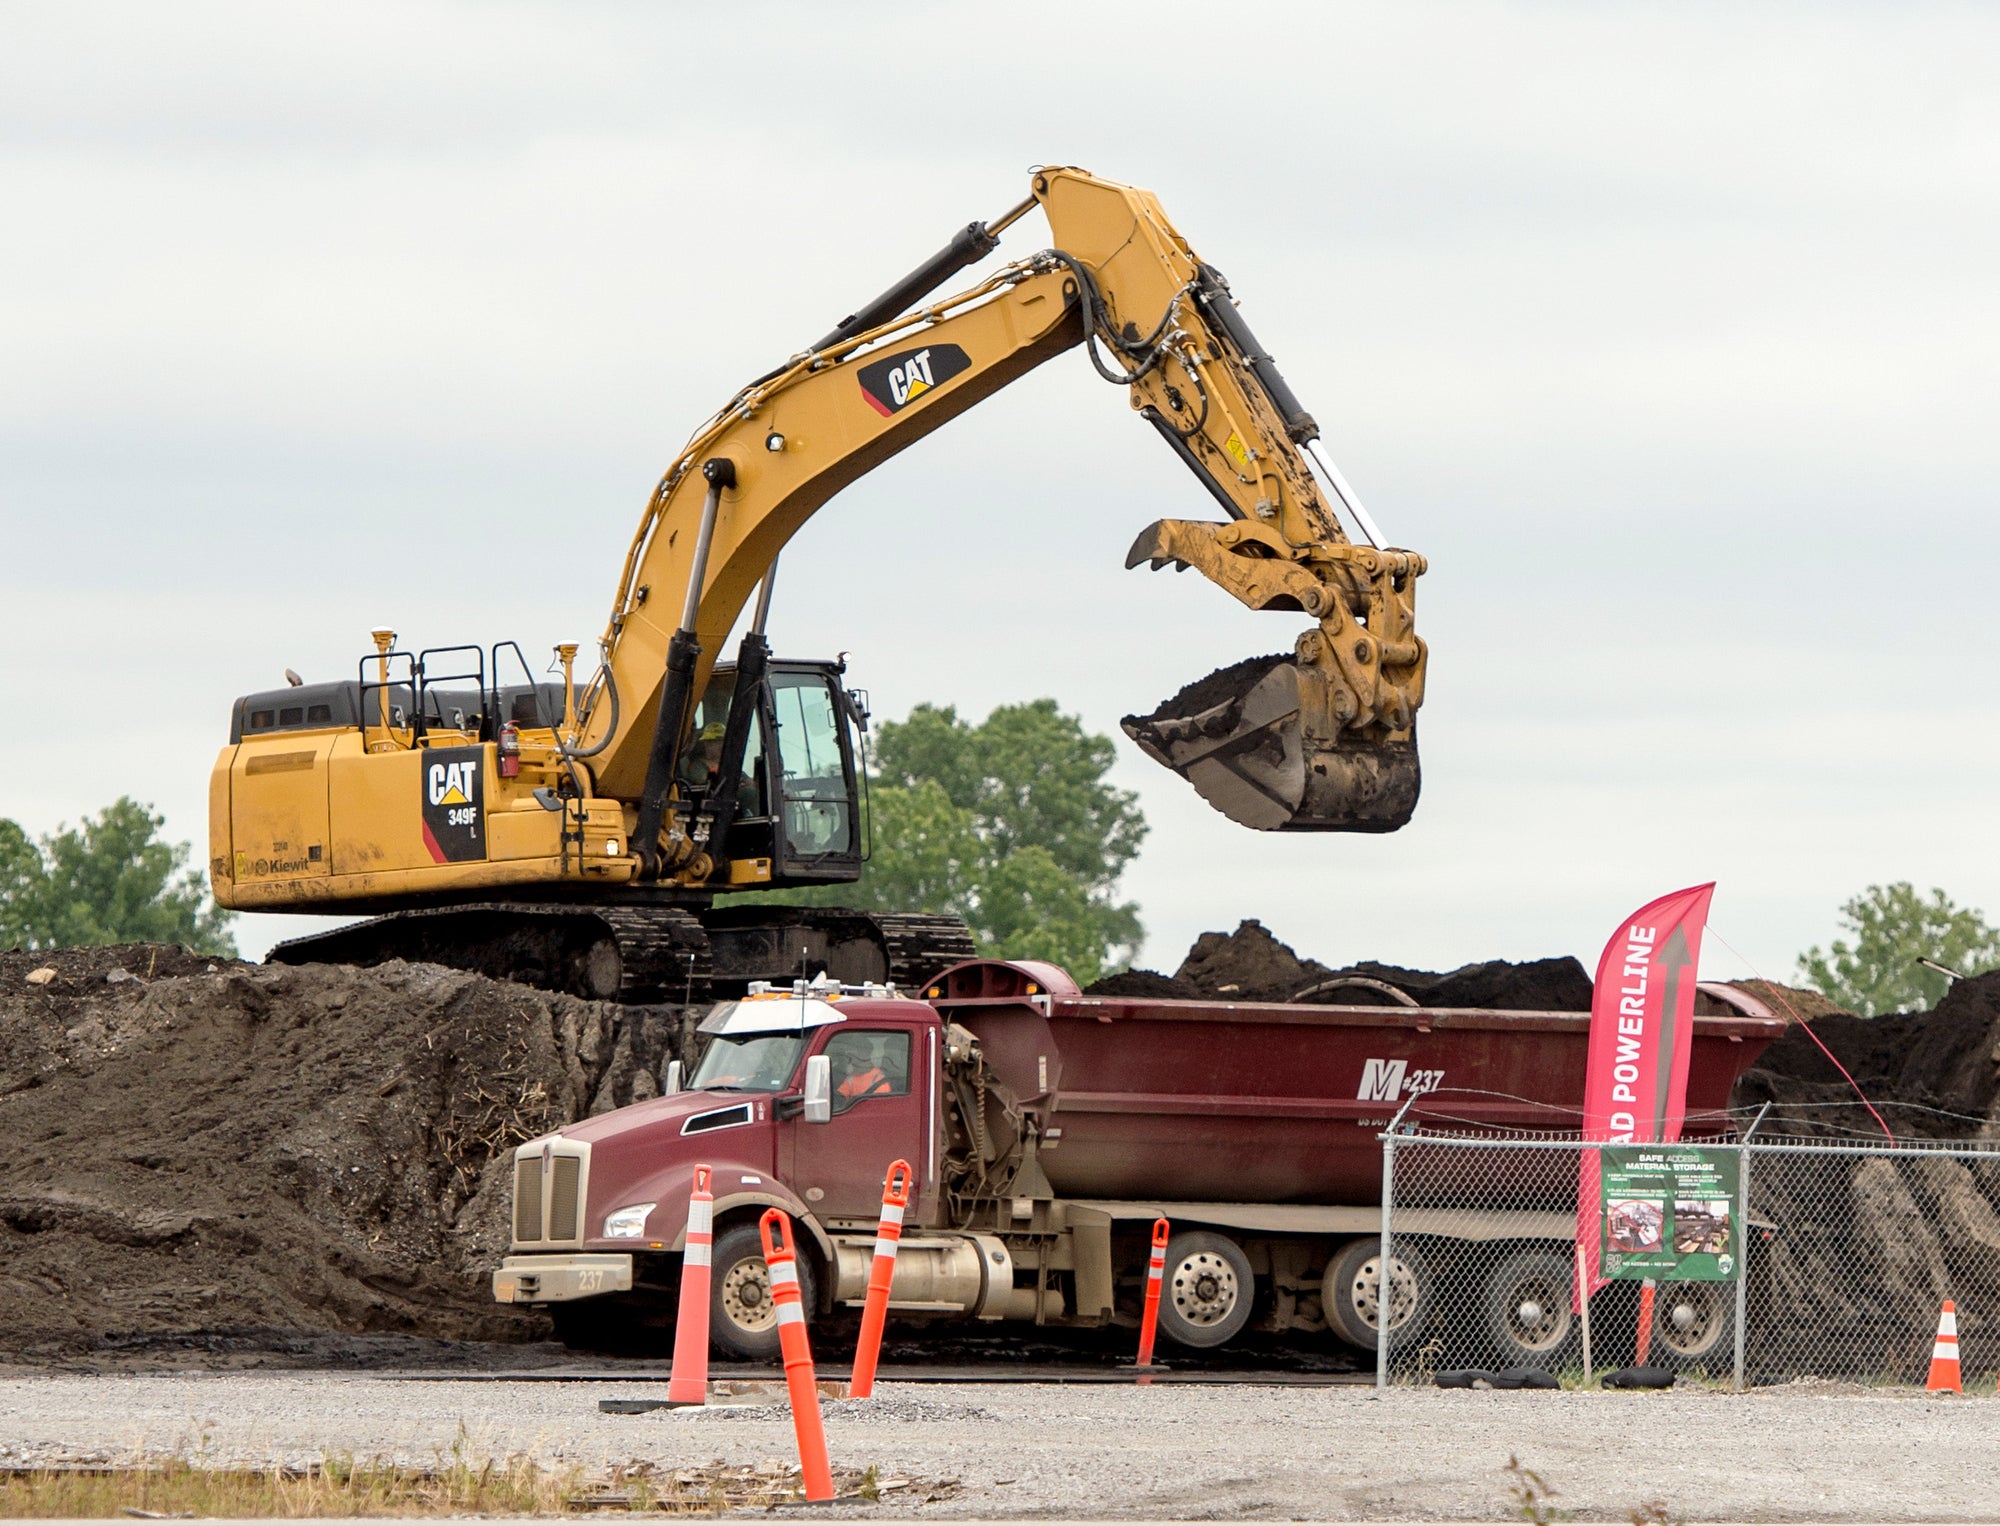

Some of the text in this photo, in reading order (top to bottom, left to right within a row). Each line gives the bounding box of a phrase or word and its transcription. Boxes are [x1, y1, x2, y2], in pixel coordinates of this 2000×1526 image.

[888, 349, 934, 405] CAT
[429, 761, 477, 806] CAT
[448, 807, 477, 826] 349F
[270, 858, 308, 874] Kiewit
[1612, 925, 1657, 1102] POWERLINE
[1625, 1162, 1715, 1171] MATERIAL STORAGE
[1638, 1154, 1700, 1163] SAFE ACCESS
[578, 1270, 604, 1290] 237
